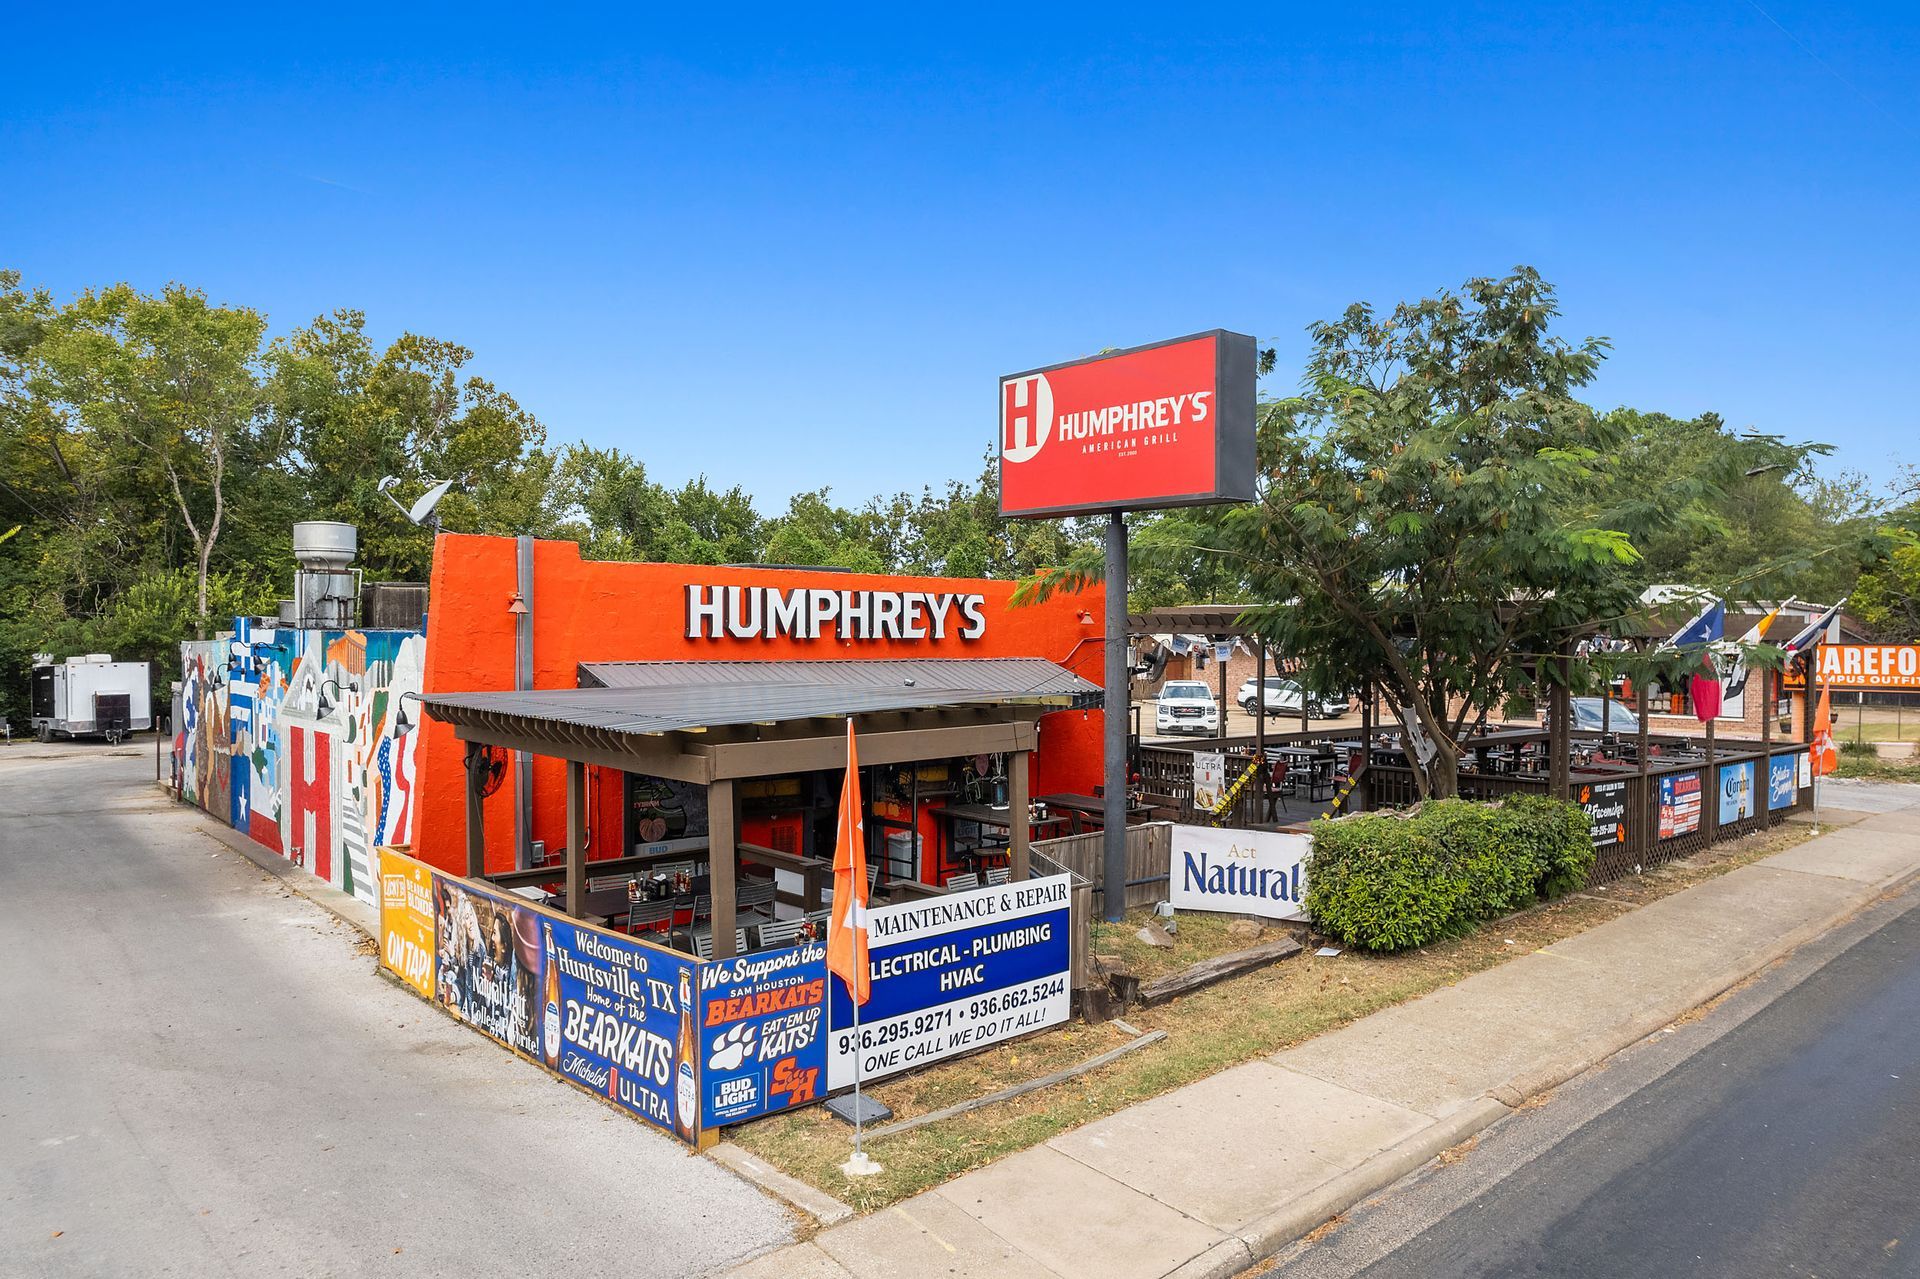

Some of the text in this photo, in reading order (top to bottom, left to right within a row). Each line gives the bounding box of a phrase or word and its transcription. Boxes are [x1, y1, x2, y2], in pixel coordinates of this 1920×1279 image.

[1059, 391, 1213, 442] HUMPHREY'S
[1082, 432, 1178, 454] AMERICAN GRILL
[685, 584, 986, 640] HUMPHREY'S
[1816, 648, 1920, 676] AREFO
[1816, 675, 1865, 684] AMPUS
[1195, 762, 1222, 771] ULTRA
[648, 846, 668, 855] BUD
[1227, 843, 1257, 859] Act
[1183, 850, 1301, 903] Natural
[874, 883, 1067, 938] MAINTENANCE & REPAIR
[387, 930, 431, 990] ON TAP!
[575, 930, 648, 973] Welcome to
[702, 944, 826, 990] We Support the
[869, 944, 961, 981] LECTRICAL
[972, 923, 1051, 957] PLUMBING
[473, 965, 502, 1006] Natural
[556, 946, 677, 1015] Huntsville, TX
[730, 975, 804, 998] SAM HOUSTON
[940, 964, 984, 992] HVAC
[970, 978, 1064, 1020] 936.662.5244
[587, 986, 647, 1023] Home of the
[704, 978, 824, 1028] BEARKATS
[805, 1006, 821, 1022] UP
[563, 999, 673, 1086] BEARKATS
[758, 1020, 818, 1062] KATS!
[864, 1007, 1046, 1073] ONE CALL WE DO IT ALL!
[562, 1051, 672, 1125] Michelob ULTRA
[715, 1087, 757, 1109] LIGHT
[721, 1078, 752, 1095] BUD
